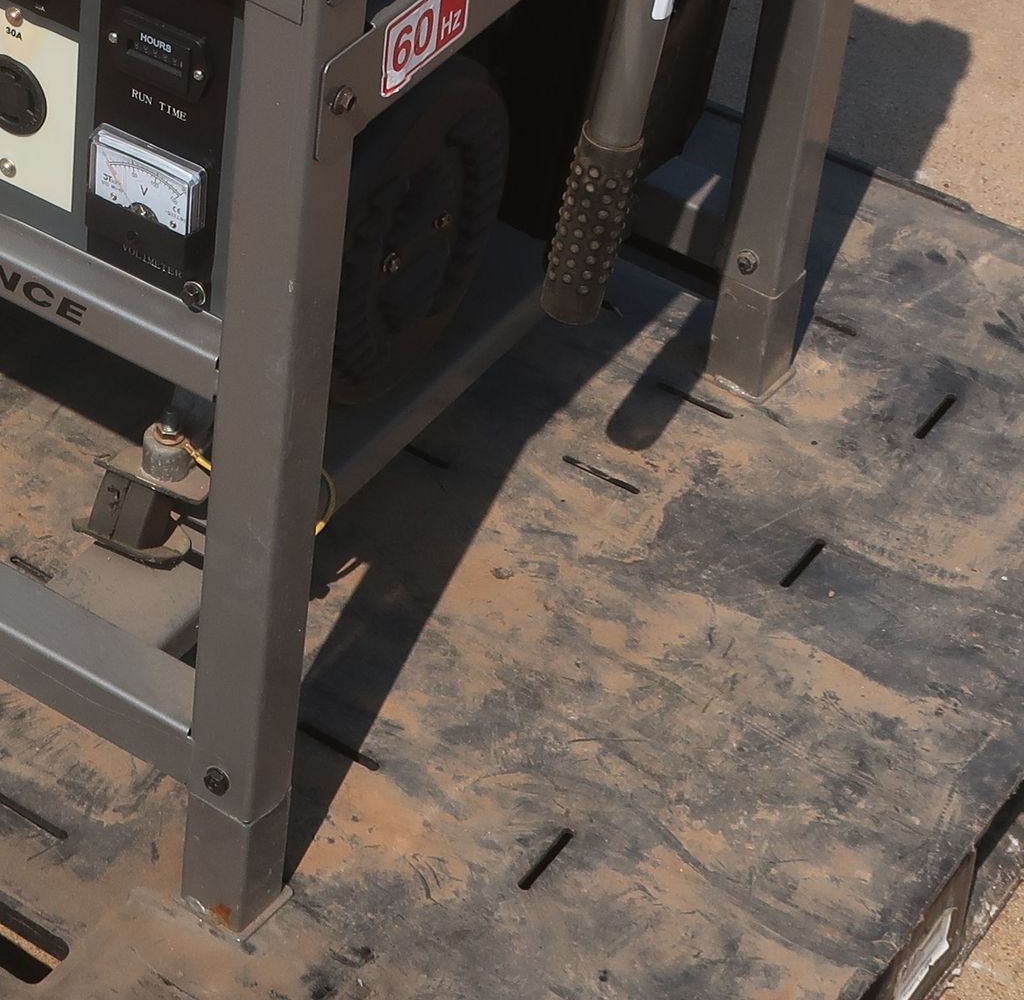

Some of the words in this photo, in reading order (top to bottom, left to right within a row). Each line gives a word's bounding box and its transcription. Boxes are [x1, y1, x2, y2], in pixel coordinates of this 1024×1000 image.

[5, 26, 23, 42] 30A
[140, 32, 172, 53] HOURS
[392, 8, 434, 74] 60
[131, 88, 153, 106] RUN
[159, 102, 187, 122] TIME
[140, 184, 149, 196] V
